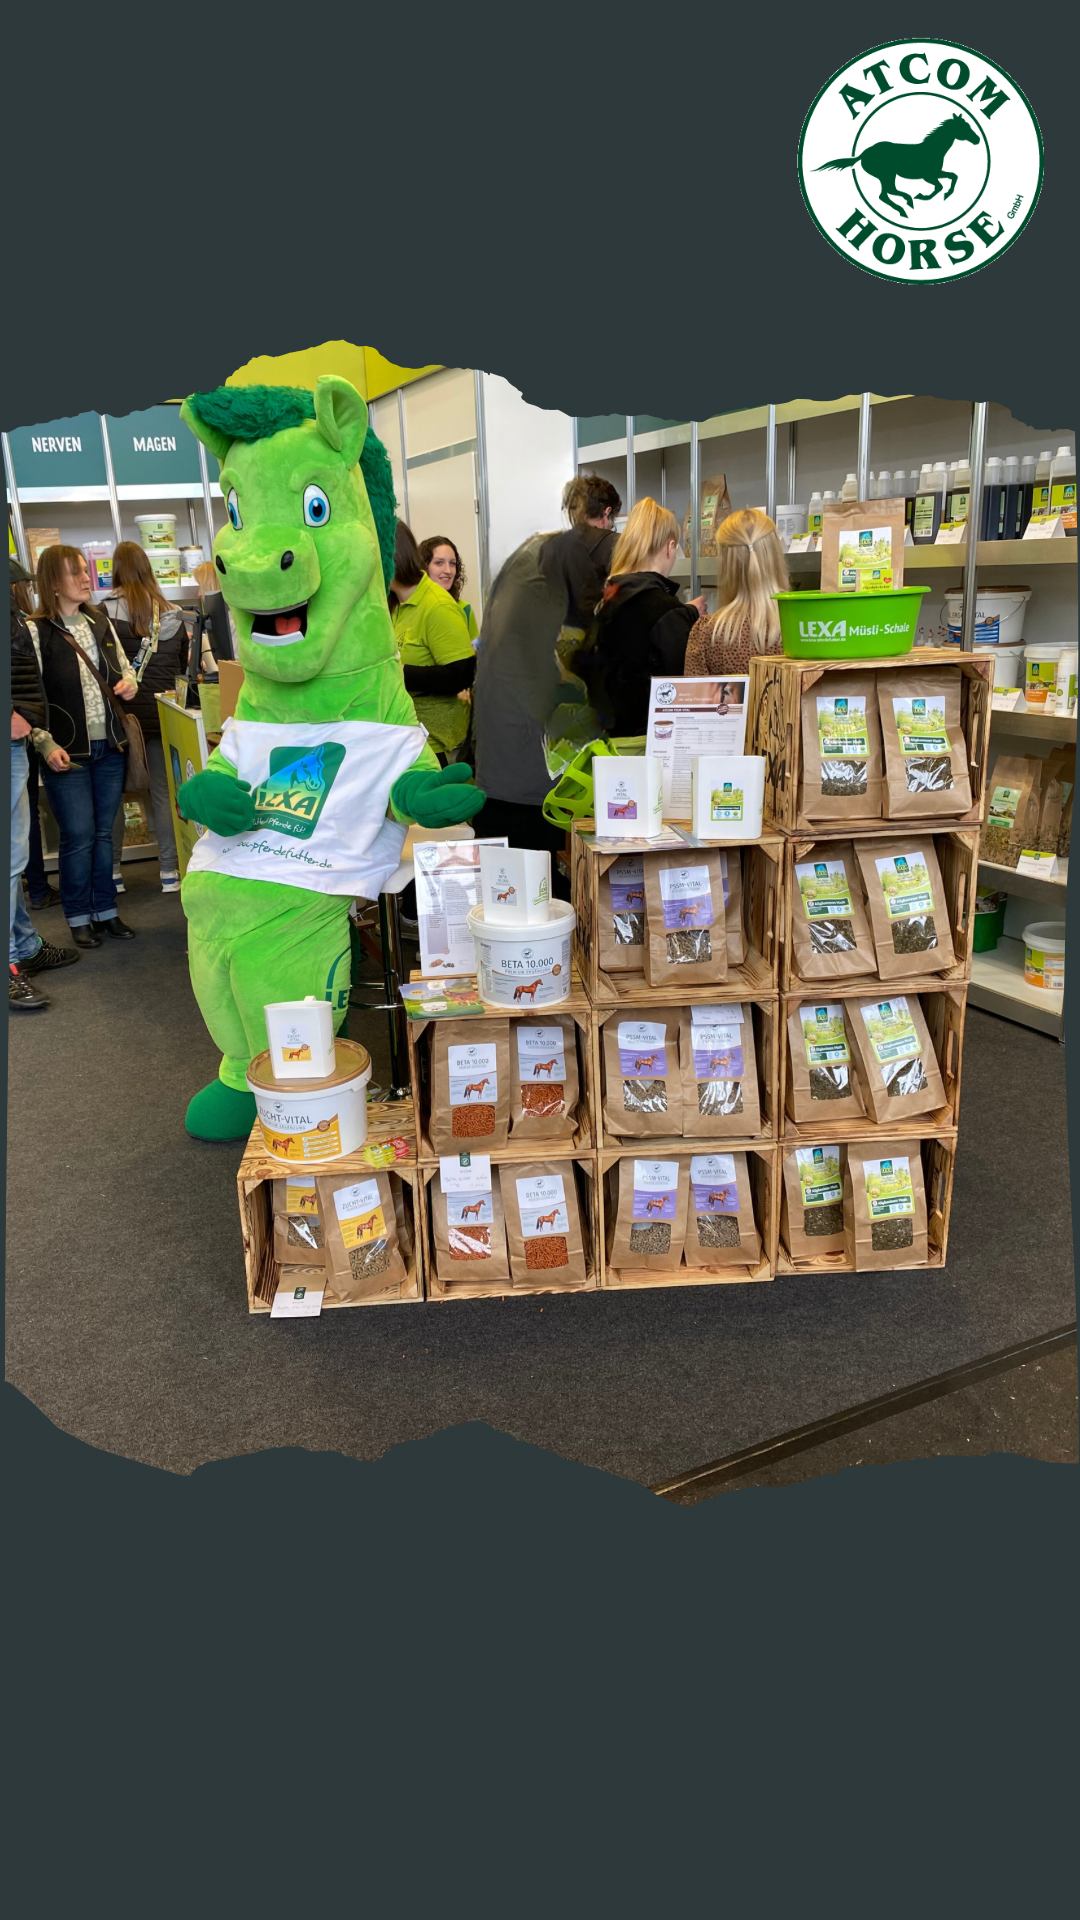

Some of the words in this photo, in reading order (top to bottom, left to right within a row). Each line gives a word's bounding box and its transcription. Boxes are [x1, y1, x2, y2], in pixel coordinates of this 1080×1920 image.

[31, 436, 82, 452] NERVEN
[132, 436, 176, 452] MAGEN
[799, 620, 847, 637] LEXA
[849, 621, 910, 636] Müsli-Schale
[669, 881, 702, 889] PSSM-VITAL
[501, 959, 523, 969] BETA
[526, 957, 554, 968] 10.000
[258, 1105, 313, 1125] ZUCHT-VITAL
[342, 1195, 375, 1210] ZUCHT-VITAL
[525, 1191, 539, 1199] BETA
